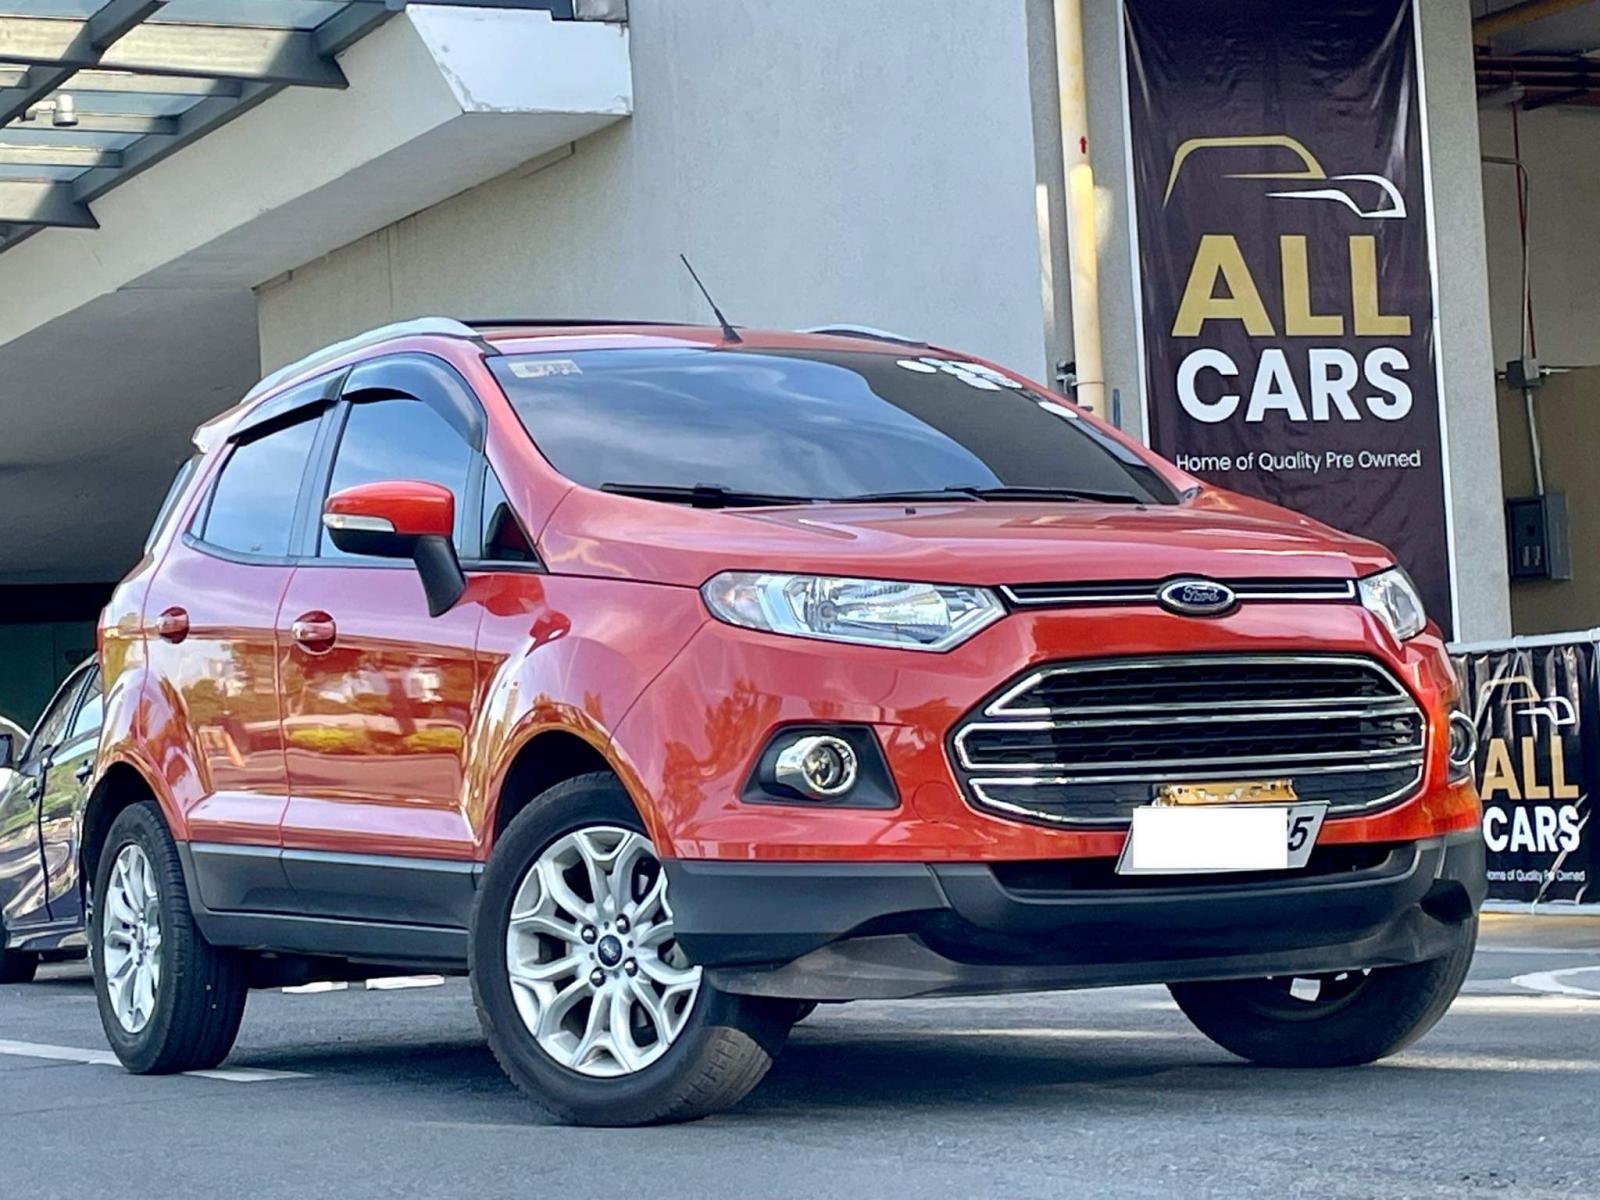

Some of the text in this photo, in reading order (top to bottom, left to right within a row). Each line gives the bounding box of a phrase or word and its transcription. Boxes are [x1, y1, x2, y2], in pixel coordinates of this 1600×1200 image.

[1171, 234, 1412, 336] ALL
[1176, 347, 1413, 423] CARS
[1176, 450, 1422, 474] Home of Quality Pre Owned
[1480, 736, 1579, 799] ALL
[1482, 804, 1580, 852] CARS
